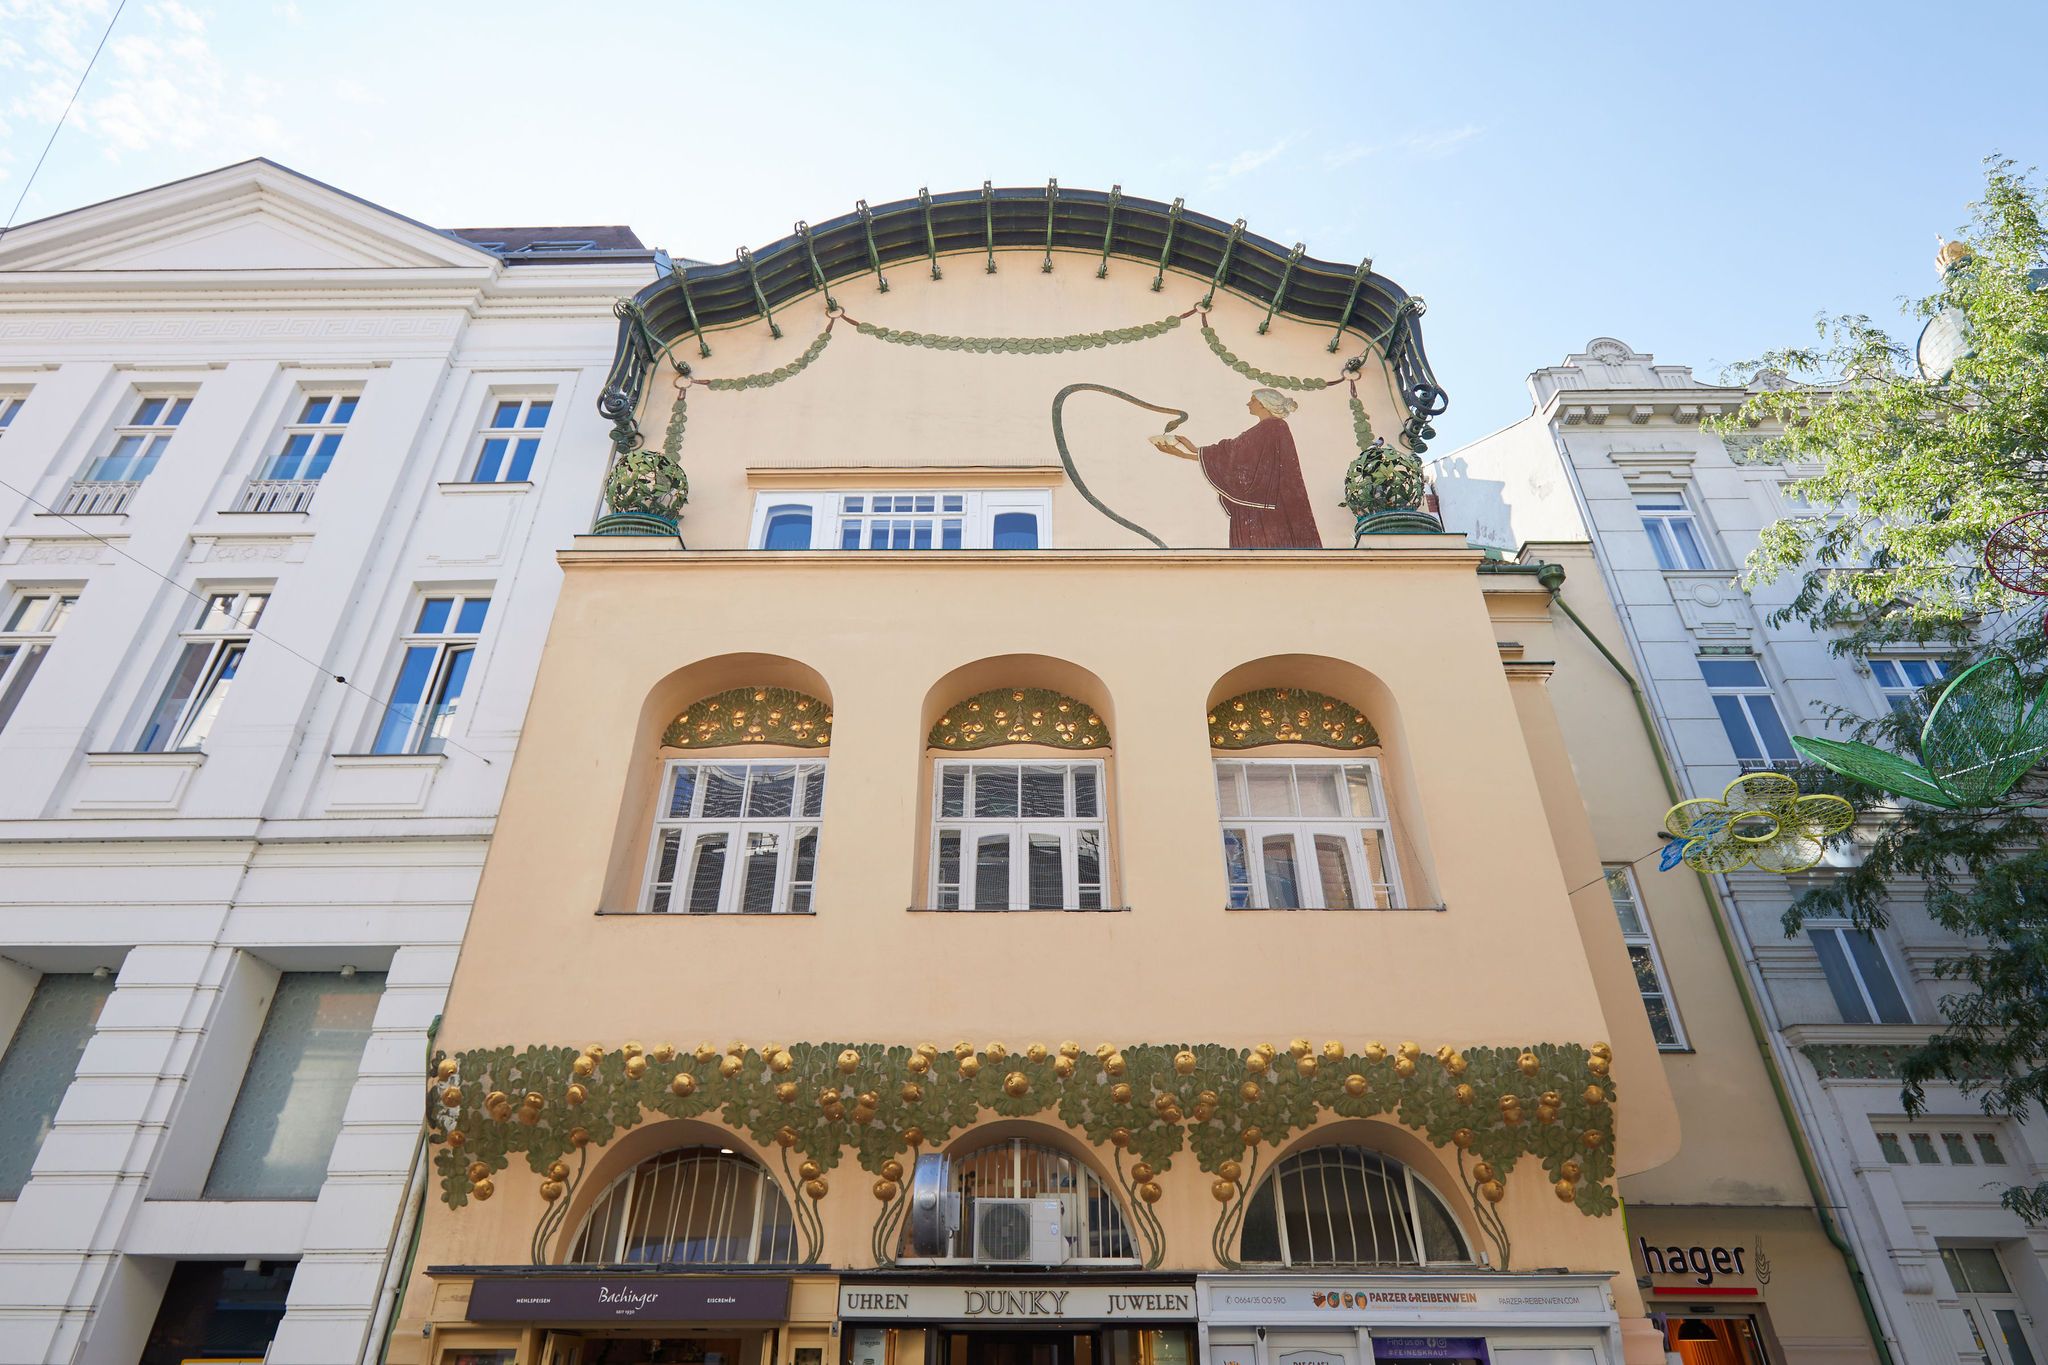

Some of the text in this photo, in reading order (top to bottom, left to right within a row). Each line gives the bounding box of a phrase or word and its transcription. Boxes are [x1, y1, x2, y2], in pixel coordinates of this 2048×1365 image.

[1639, 1236, 1745, 1285] hager
[598, 1286, 659, 1310] Bachinger
[847, 1290, 1189, 1316] UHREN DUNKY JUWELEN
[1369, 1292, 1407, 1303] PARZER
[1387, 1338, 1403, 1346] Find
